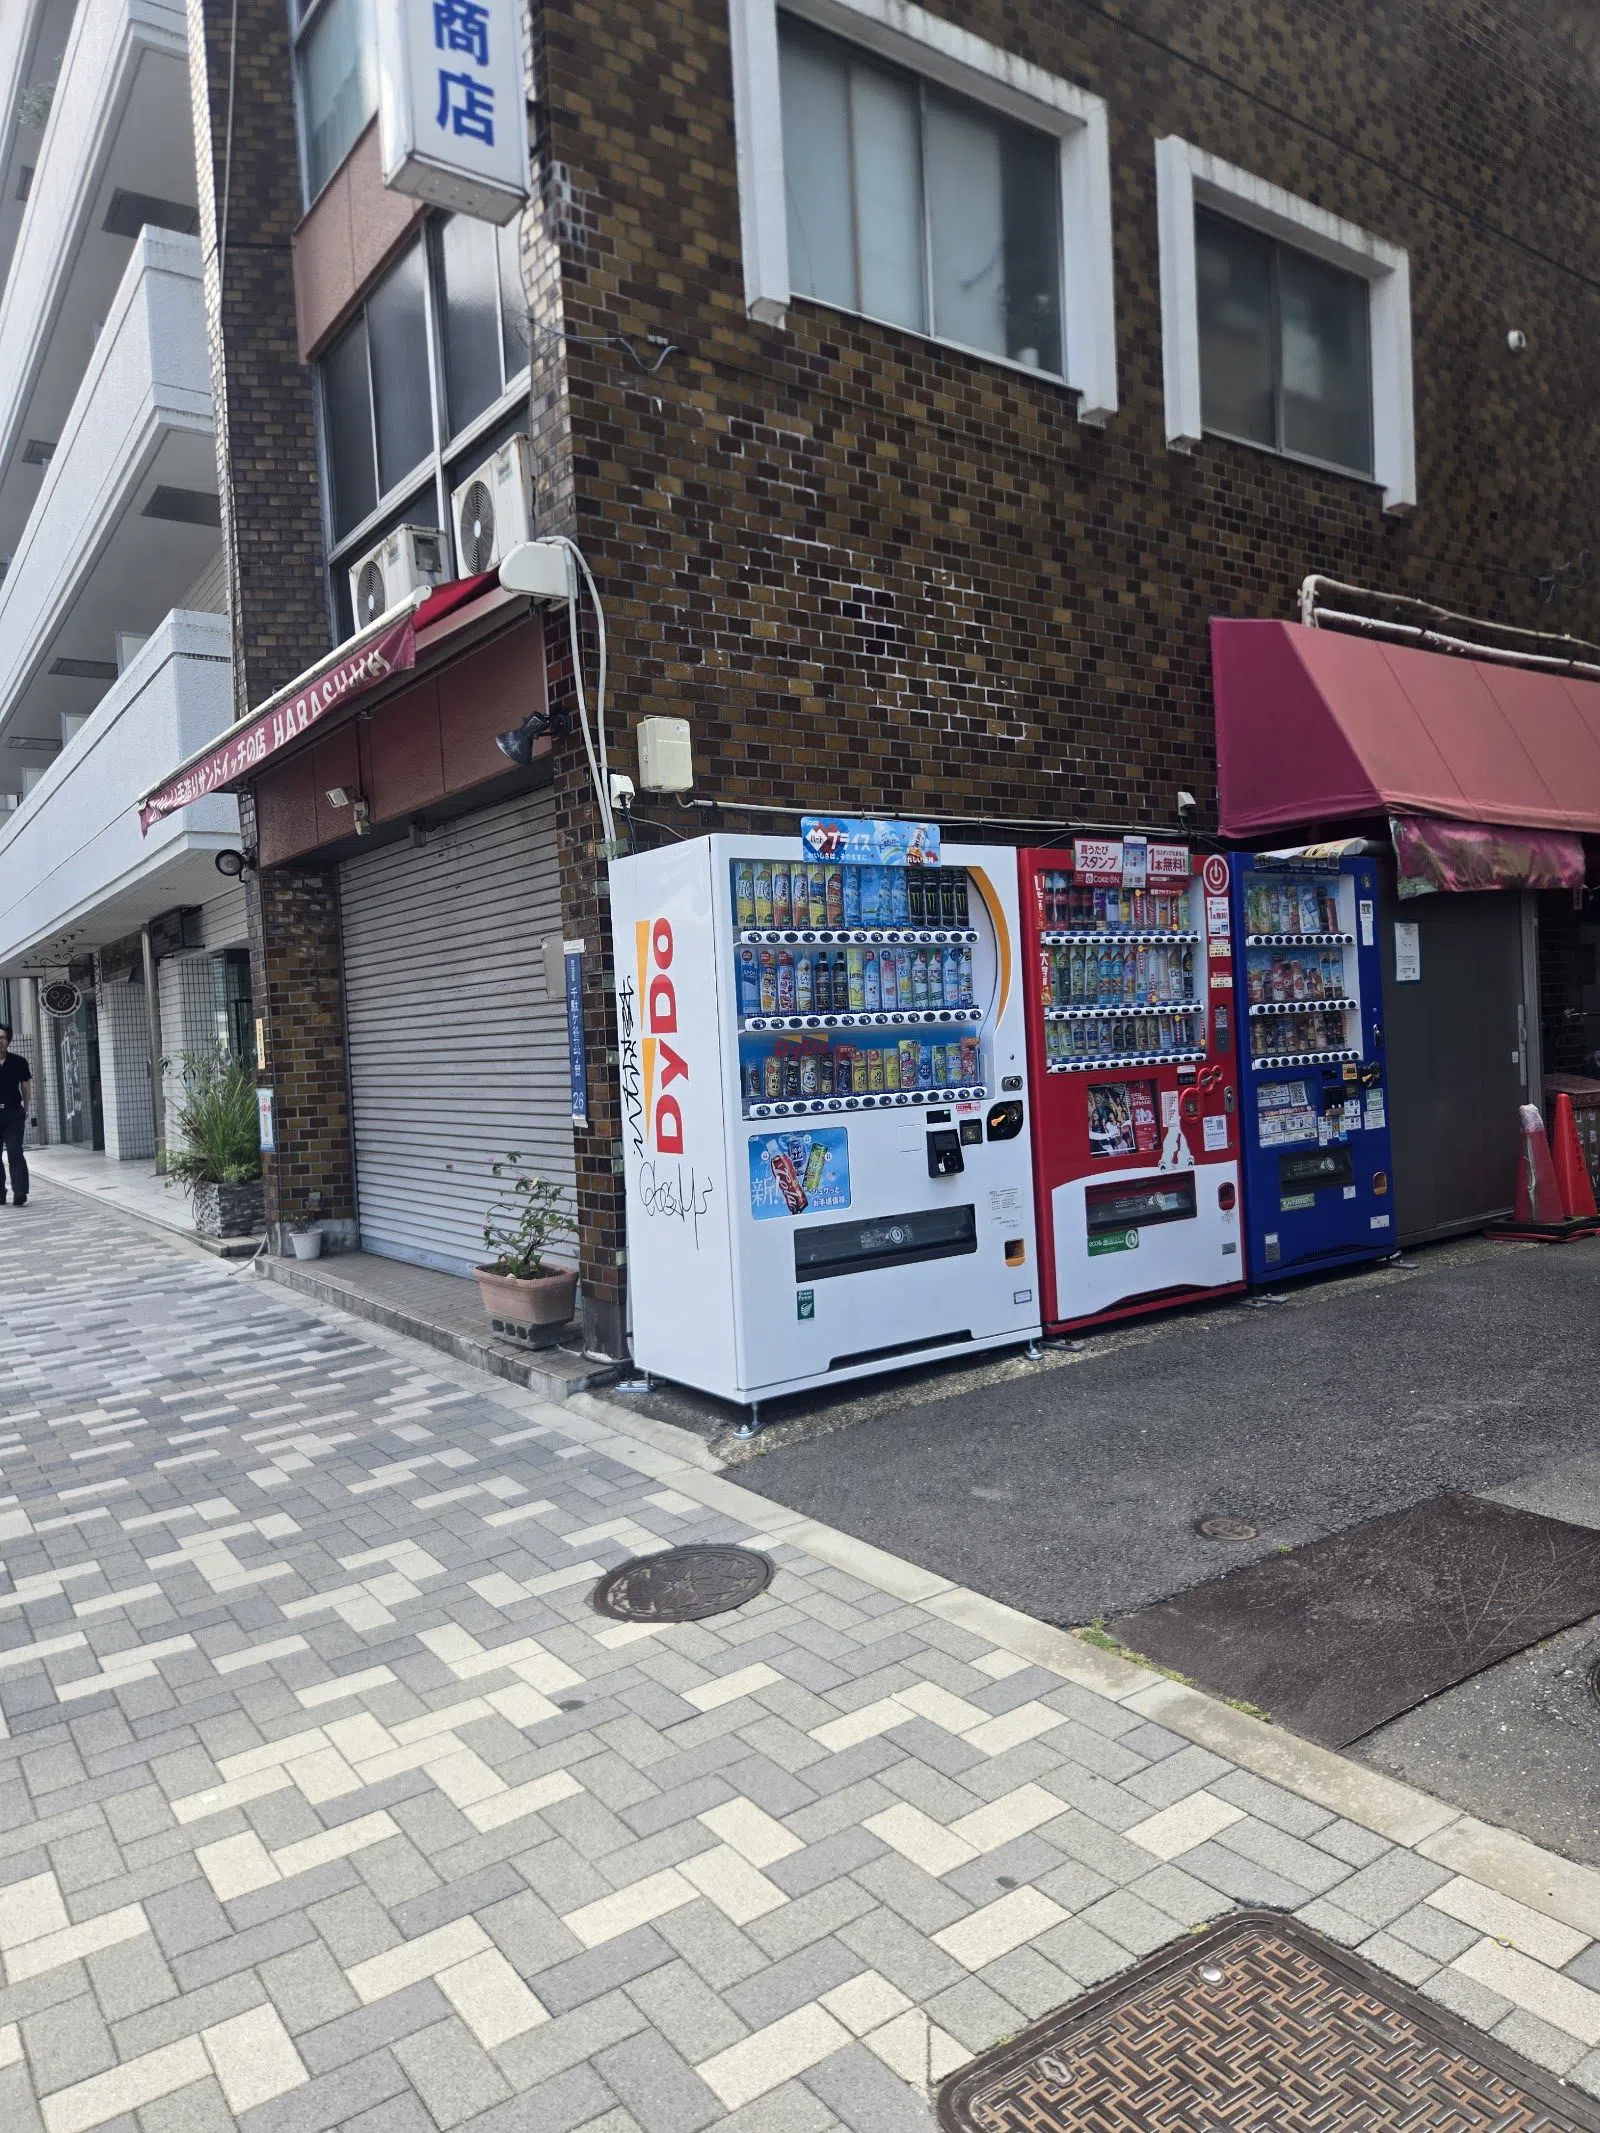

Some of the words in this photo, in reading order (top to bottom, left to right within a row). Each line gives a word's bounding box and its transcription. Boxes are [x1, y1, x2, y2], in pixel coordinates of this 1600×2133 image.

[433, 0, 495, 147] 商店
[1080, 844, 1109, 856] 買うたび
[1080, 855, 1118, 870] スタンプ
[1093, 875, 1109, 884] Coke
[572, 1092, 584, 1110] 26
